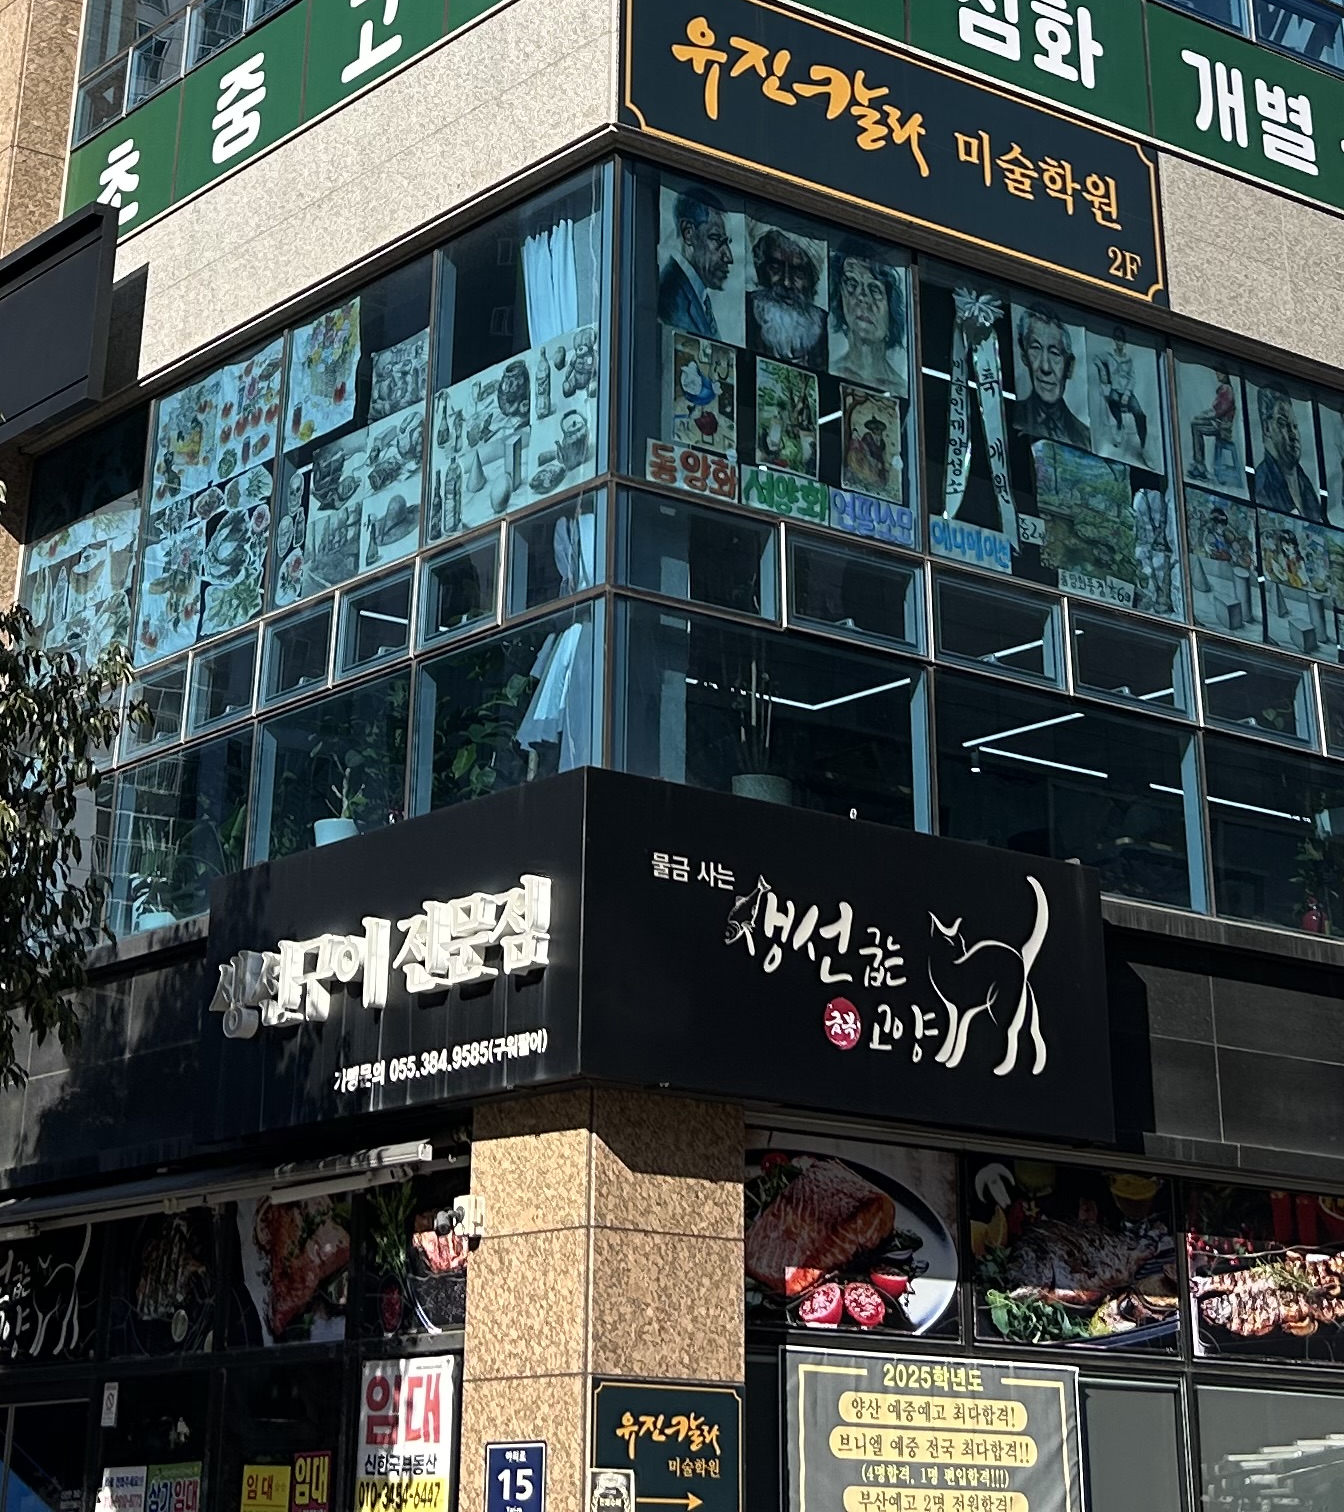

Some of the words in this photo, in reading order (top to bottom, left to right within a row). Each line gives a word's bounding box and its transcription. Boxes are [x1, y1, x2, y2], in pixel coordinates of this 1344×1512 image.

[1182, 48, 1318, 177] 개별
[954, 130, 1123, 231] 미술학원
[1107, 245, 1142, 282] 2F
[650, 443, 737, 499] 동양화
[744, 469, 828, 522] 서양화
[651, 852, 690, 883] 물금
[696, 862, 735, 890] 사는
[208, 916, 391, 1039] 생선구이
[393, 874, 552, 993] 전문점
[883, 1363, 984, 1392] 2025학년도
[365, 1372, 441, 1445] 임대
[851, 1396, 881, 1420] 양산
[887, 1399, 947, 1422] 예중예고
[952, 1403, 1016, 1428] 최다합격!
[365, 1454, 438, 1476] 신한국부동산
[837, 1432, 883, 1457] 브니엘
[889, 1435, 920, 1459] 예중
[925, 1436, 956, 1460] 전국
[960, 1438, 1030, 1464] 최다합격!!
[294, 1455, 330, 1506] 임대
[497, 1468, 534, 1502] 15
[668, 1456, 721, 1479] 미술학원
[920, 1466, 938, 1486] 1명
